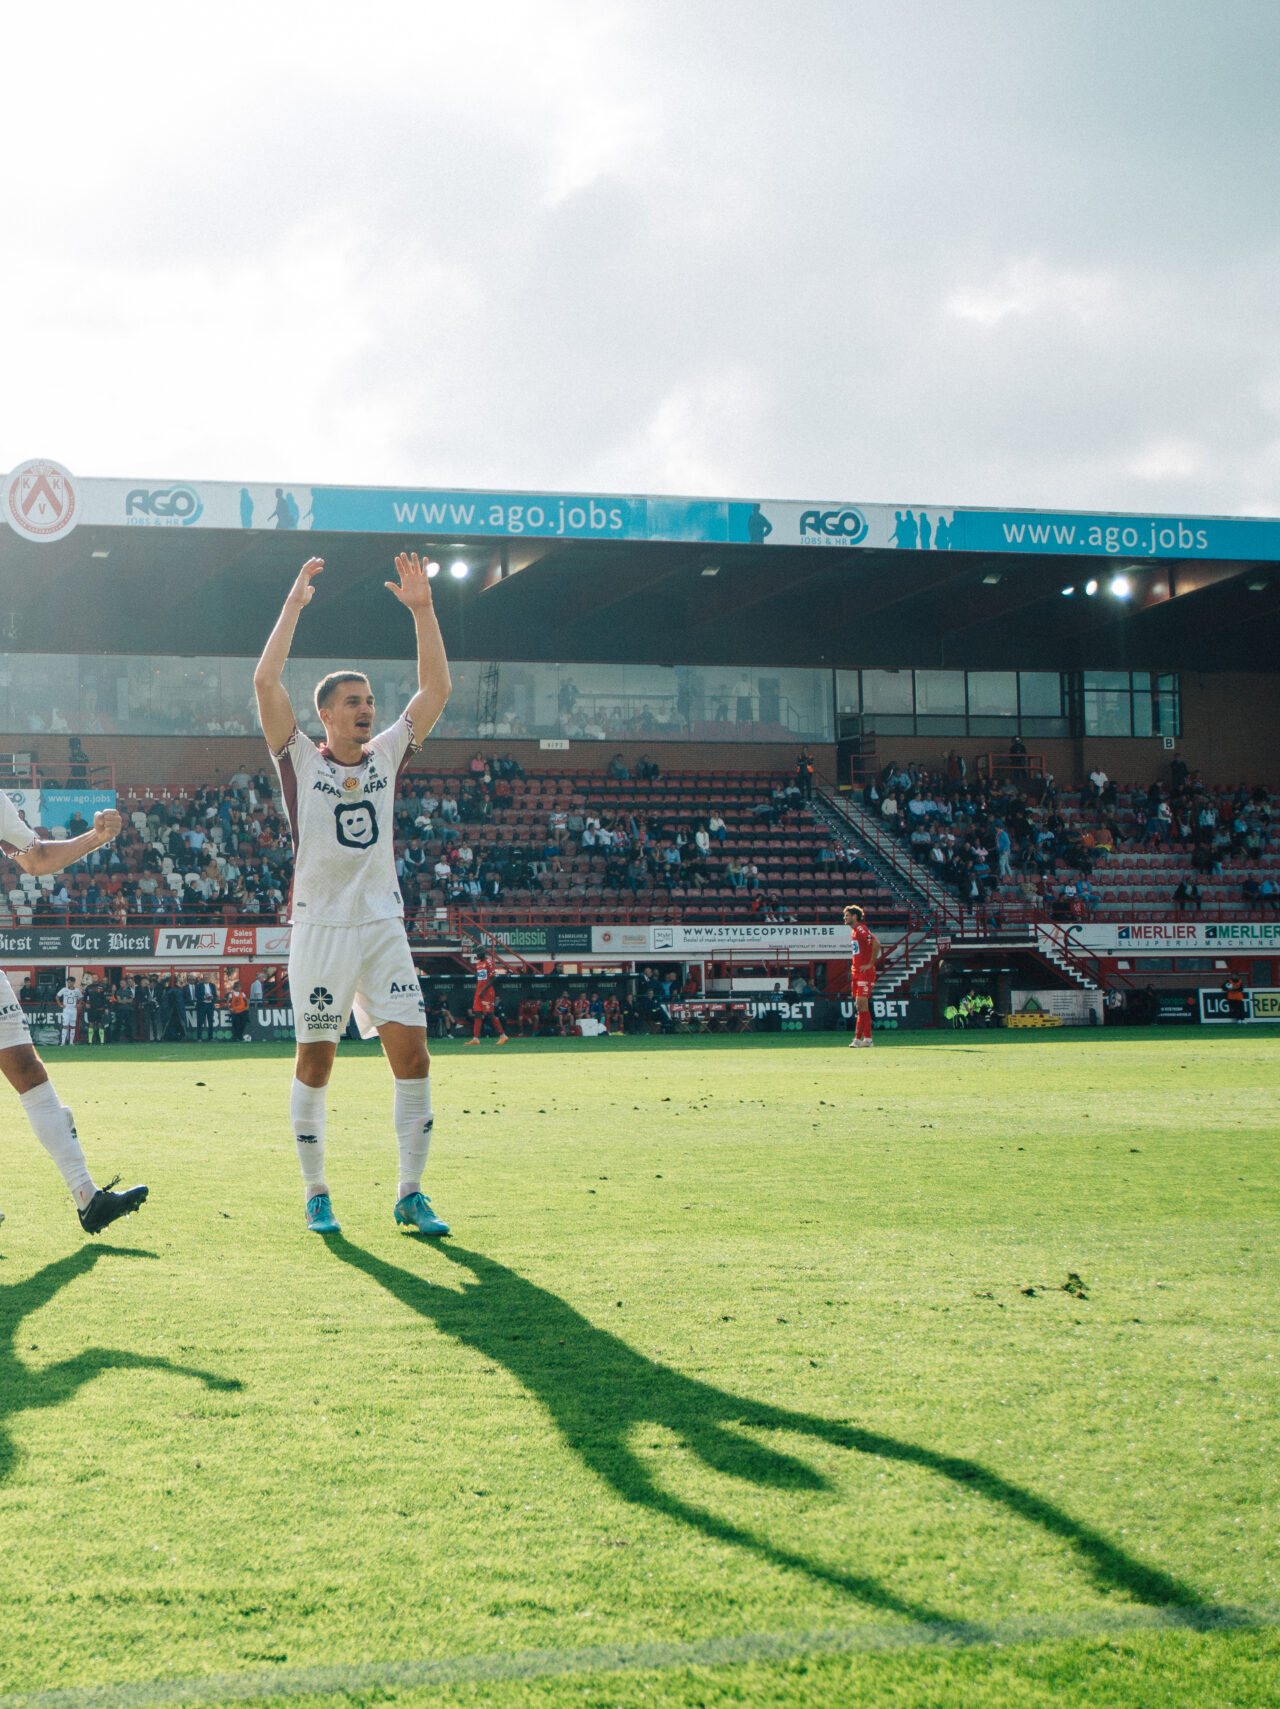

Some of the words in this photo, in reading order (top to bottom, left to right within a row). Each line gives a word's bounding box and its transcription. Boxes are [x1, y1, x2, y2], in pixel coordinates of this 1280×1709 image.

[125, 488, 195, 516] AGO
[125, 517, 151, 526] JOBS
[165, 518, 180, 527] HR
[393, 499, 622, 534] www.ago.jobs
[799, 509, 861, 537] AGO
[799, 537, 822, 545] JOBS
[835, 538, 848, 546] HR
[1003, 521, 1209, 553] www.ago.jobs
[1165, 738, 1173, 748] B
[313, 781, 342, 798] AFAS
[363, 776, 388, 794] AFAS
[48, 793, 111, 804] www.ago.jobs
[683, 928, 835, 936] WWW.STYLECOPYPRINT.BE
[1131, 925, 1197, 939] MERLIER
[71, 933, 100, 950] Ter
[107, 932, 150, 951] Biest
[165, 934, 201, 949] TVH
[227, 945, 253, 953] Service
[1207, 999, 1250, 1013] LIGT
[303, 1012, 342, 1023] Golden
[308, 1022, 338, 1031] palace
